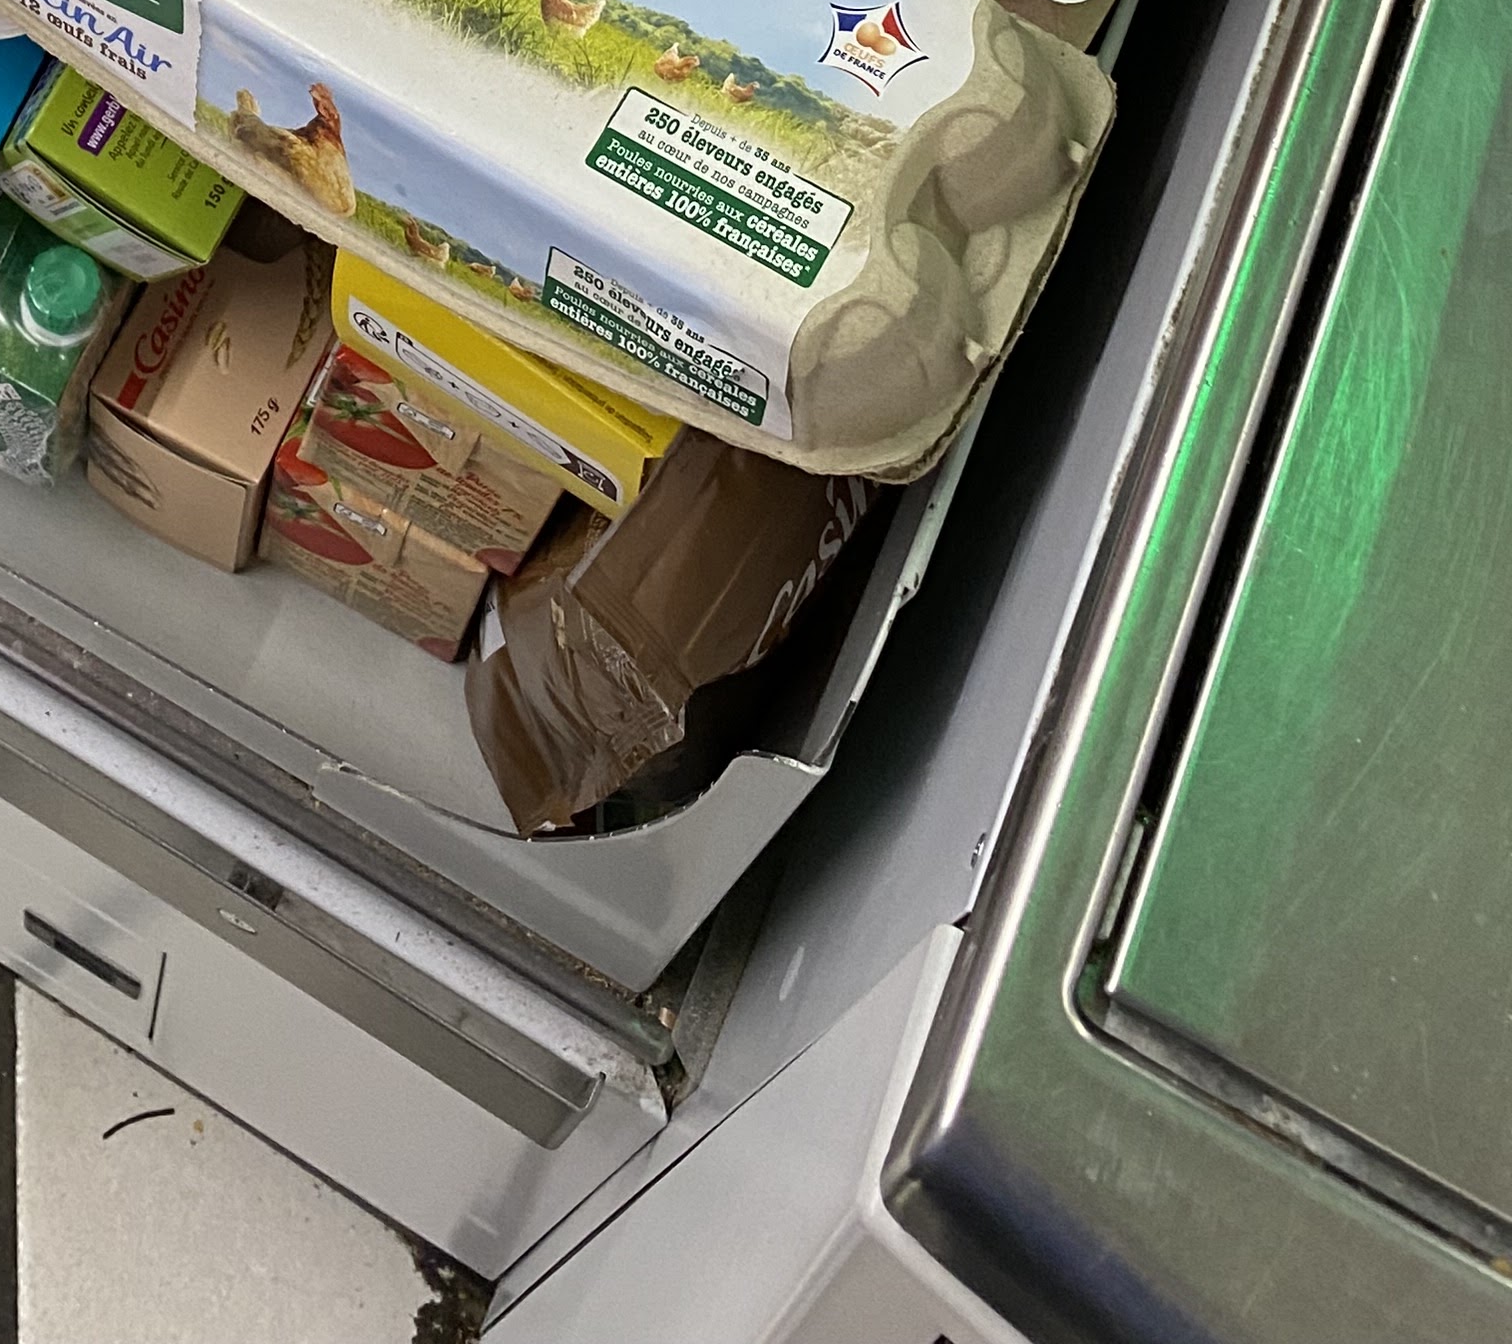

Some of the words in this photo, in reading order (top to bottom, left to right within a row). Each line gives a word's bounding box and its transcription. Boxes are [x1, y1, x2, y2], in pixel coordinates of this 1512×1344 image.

[46, 11, 95, 50] œufs
[99, 43, 148, 81] frais
[103, 27, 173, 73] Air
[833, 48, 848, 61] DE
[848, 55, 886, 80] FRANCE
[61, 119, 78, 136] Un
[108, 121, 137, 161] Appelez
[644, 107, 681, 136] 250
[683, 126, 752, 177] éleveurs
[755, 166, 824, 215] engagés
[690, 114, 728, 139] Depuis
[754, 147, 771, 162] 35
[770, 156, 791, 174] ans
[205, 184, 225, 209] 150
[595, 153, 664, 201] entières
[665, 191, 712, 229] 100%
[607, 138, 653, 172] Poules
[654, 166, 716, 206] nourries
[716, 200, 745, 222] aux
[746, 213, 819, 262] céréales
[657, 139, 692, 167] cœur
[711, 166, 735, 189] nos
[738, 181, 810, 231] campagnes
[134, 268, 205, 374] Casino
[550, 298, 614, 340] entières
[618, 335, 661, 369] 100%
[573, 265, 604, 292] 250
[608, 287, 671, 341] éleveurs
[553, 285, 597, 317] Poules
[600, 310, 656, 351] nourries
[688, 361, 758, 407] céréales
[250, 408, 270, 436] 175
[267, 398, 279, 412] g
